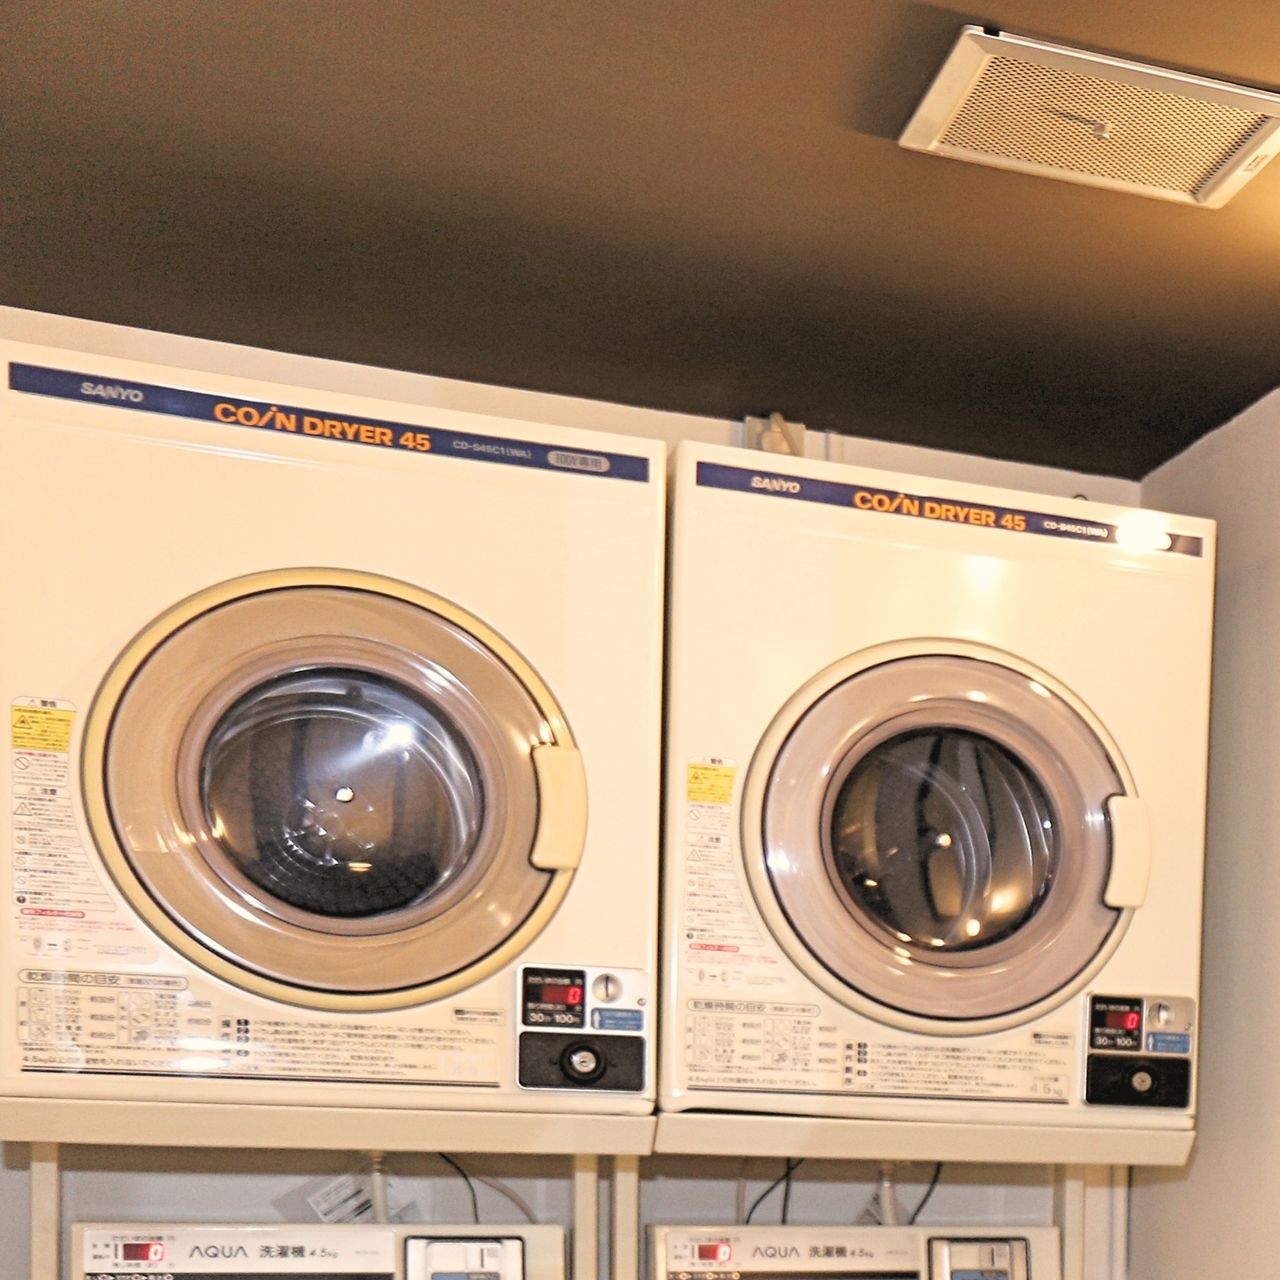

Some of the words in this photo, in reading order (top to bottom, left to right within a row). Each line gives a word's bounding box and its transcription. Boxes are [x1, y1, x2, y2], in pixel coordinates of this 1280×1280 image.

[81, 381, 145, 403] SANYO
[303, 415, 394, 447] DRYER
[398, 431, 432, 452] 45
[750, 476, 801, 494] SANYO
[924, 501, 997, 528] DRYER
[1001, 514, 1027, 532] 45
[568, 987, 581, 1004] 0
[1127, 1012, 1139, 1029] 0
[189, 1245, 249, 1259] AQUA
[260, 1245, 305, 1259] 洗濯機
[752, 1246, 800, 1259] AQUA
[809, 1245, 848, 1258] 洗濯機
